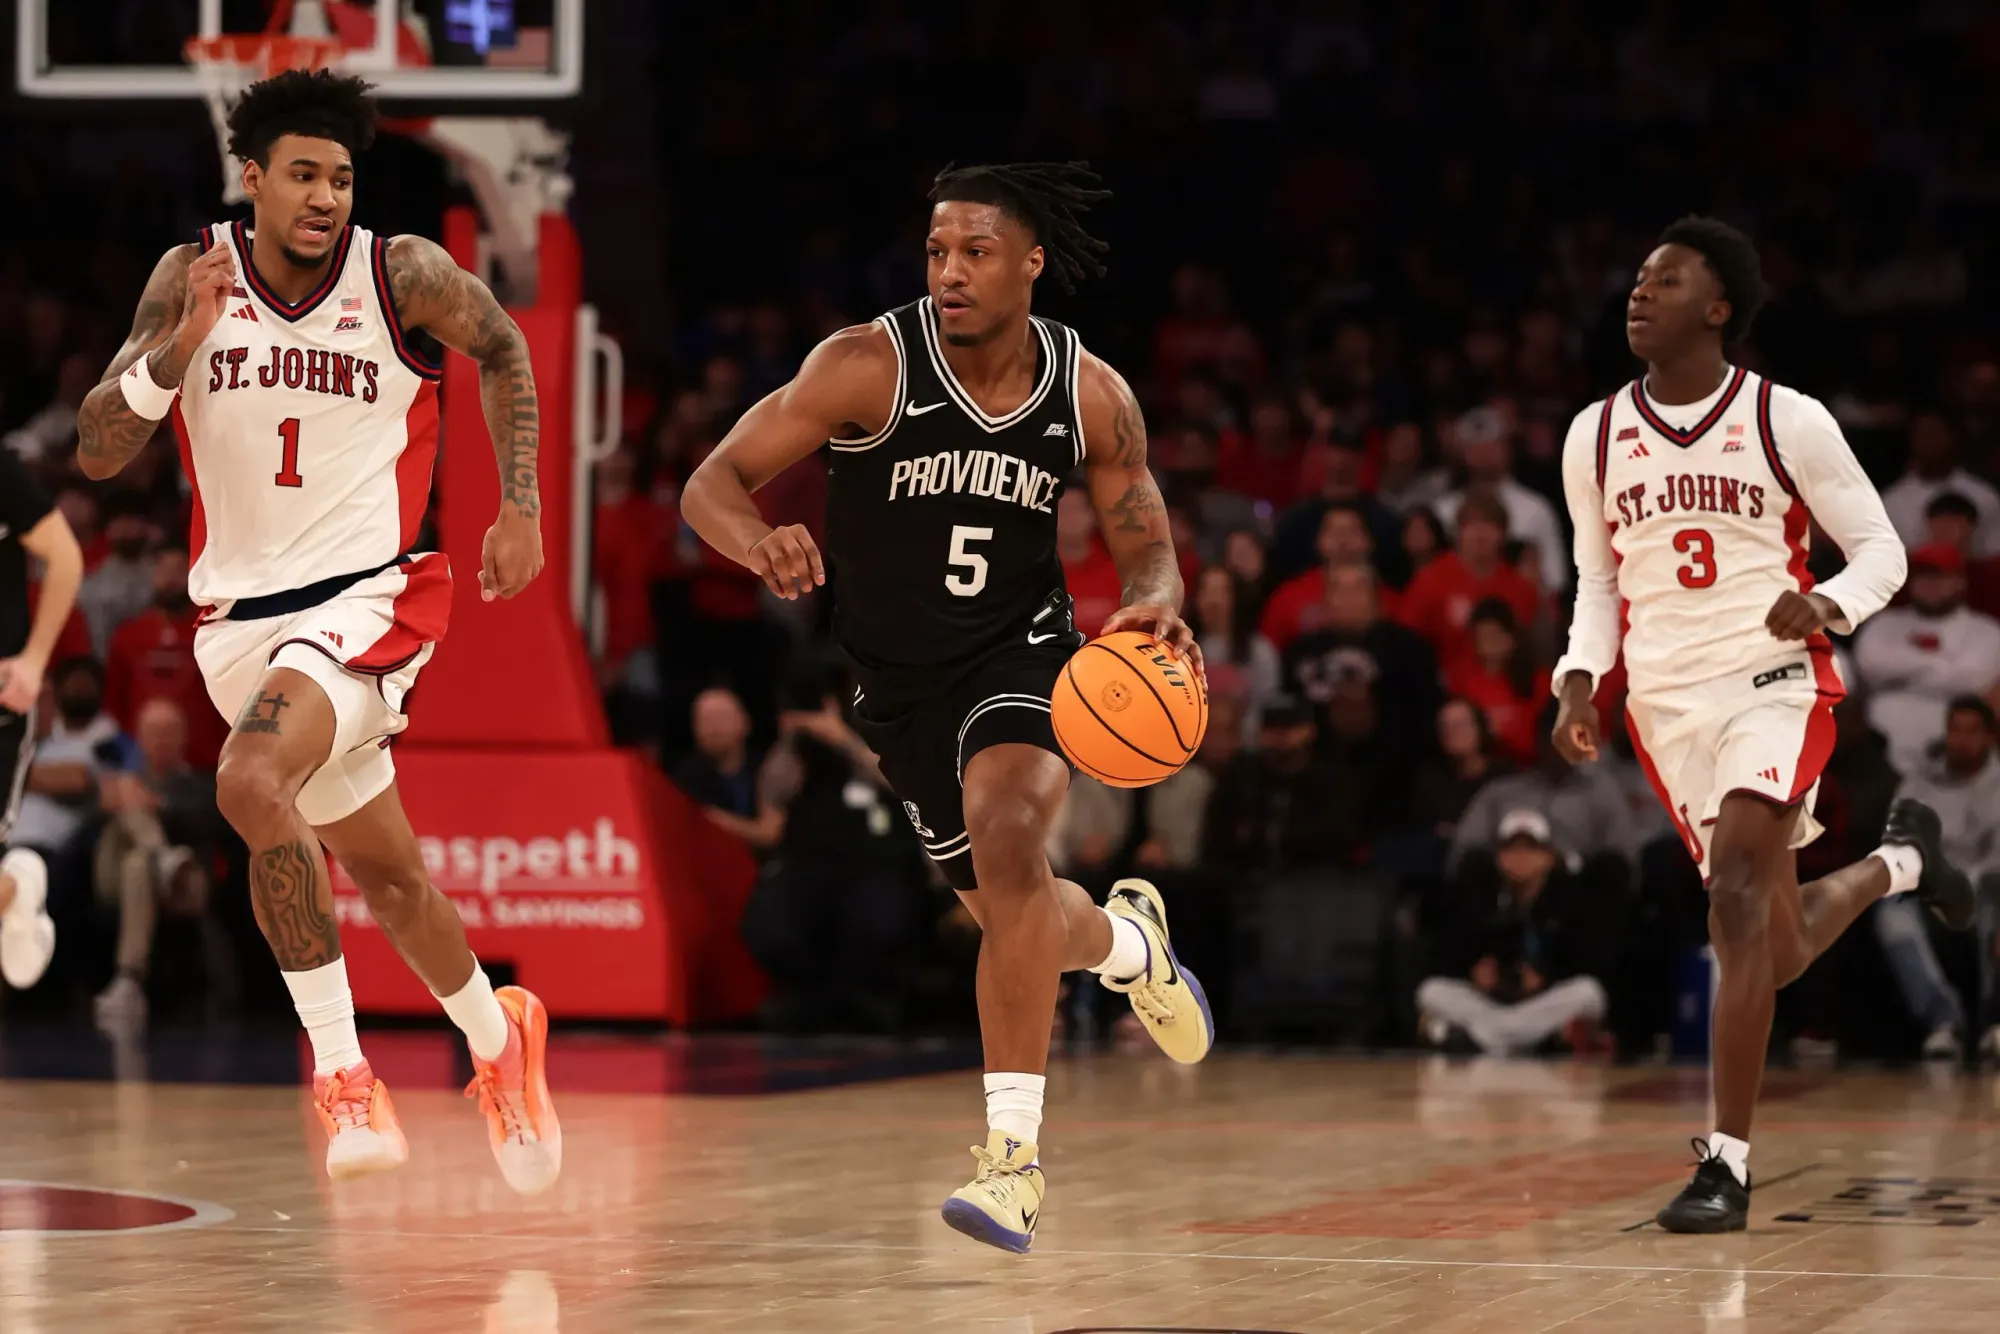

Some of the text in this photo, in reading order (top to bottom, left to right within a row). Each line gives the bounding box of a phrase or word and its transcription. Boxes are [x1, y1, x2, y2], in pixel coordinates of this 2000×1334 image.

[209, 346, 379, 404] ST. JOHN'S
[275, 417, 303, 488] 1
[888, 450, 1060, 514] PROVIDENCE
[1616, 474, 1765, 528] ST. JOHN'S
[945, 525, 993, 597] 5
[1672, 528, 1718, 589] 3
[1134, 644, 1186, 687] EVO
[417, 815, 642, 896] aspeth
